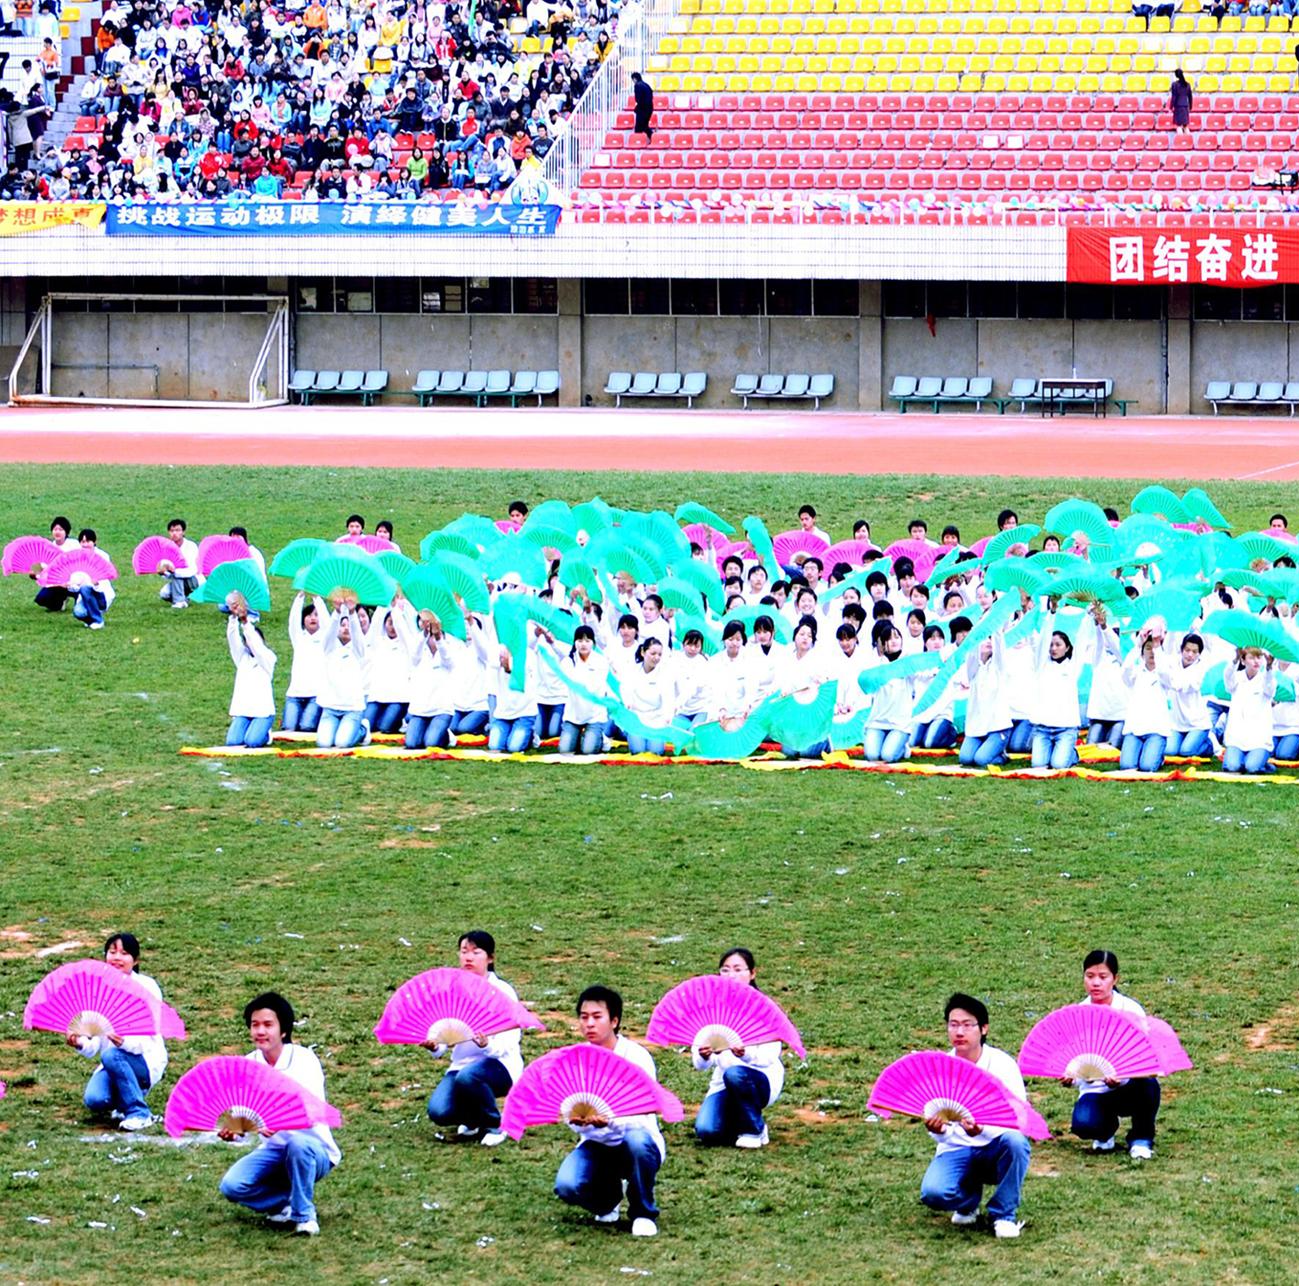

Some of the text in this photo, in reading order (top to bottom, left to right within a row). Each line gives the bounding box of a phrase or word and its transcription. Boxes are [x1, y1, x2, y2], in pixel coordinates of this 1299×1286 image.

[117, 204, 547, 227] 挑战运动极限 演绎健美人生
[1109, 233, 1279, 282] 团结奋进
